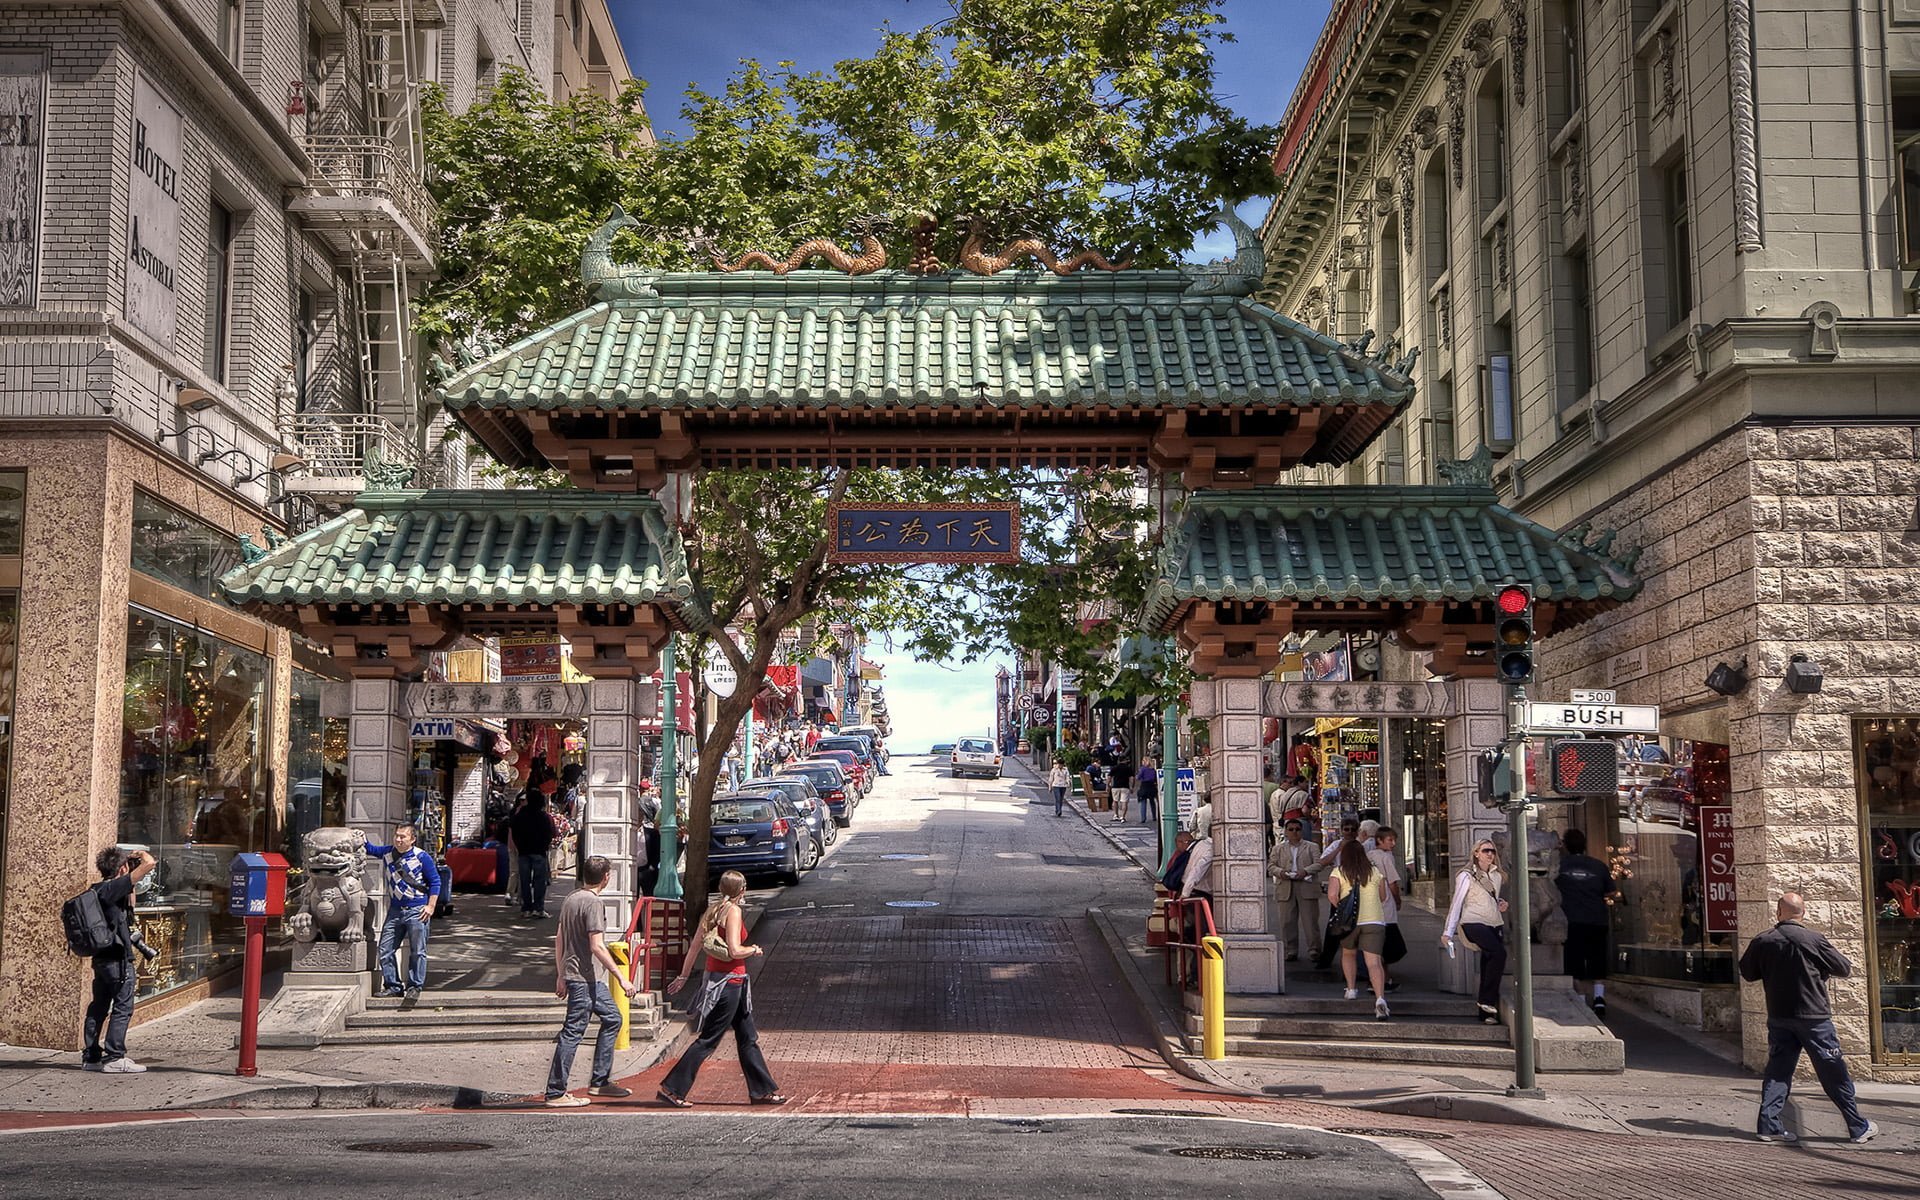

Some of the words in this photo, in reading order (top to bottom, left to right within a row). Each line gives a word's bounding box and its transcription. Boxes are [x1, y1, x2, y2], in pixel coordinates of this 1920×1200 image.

[134, 118, 179, 203] HOTEL
[130, 215, 175, 293] ASTORIA
[1588, 692, 1611, 702] 500
[1563, 709, 1623, 724] BUSH
[411, 722, 453, 736] ATM
[1348, 751, 1378, 762] PENT
[1707, 831, 1726, 839] FINE
[1709, 882, 1736, 902] 50%
